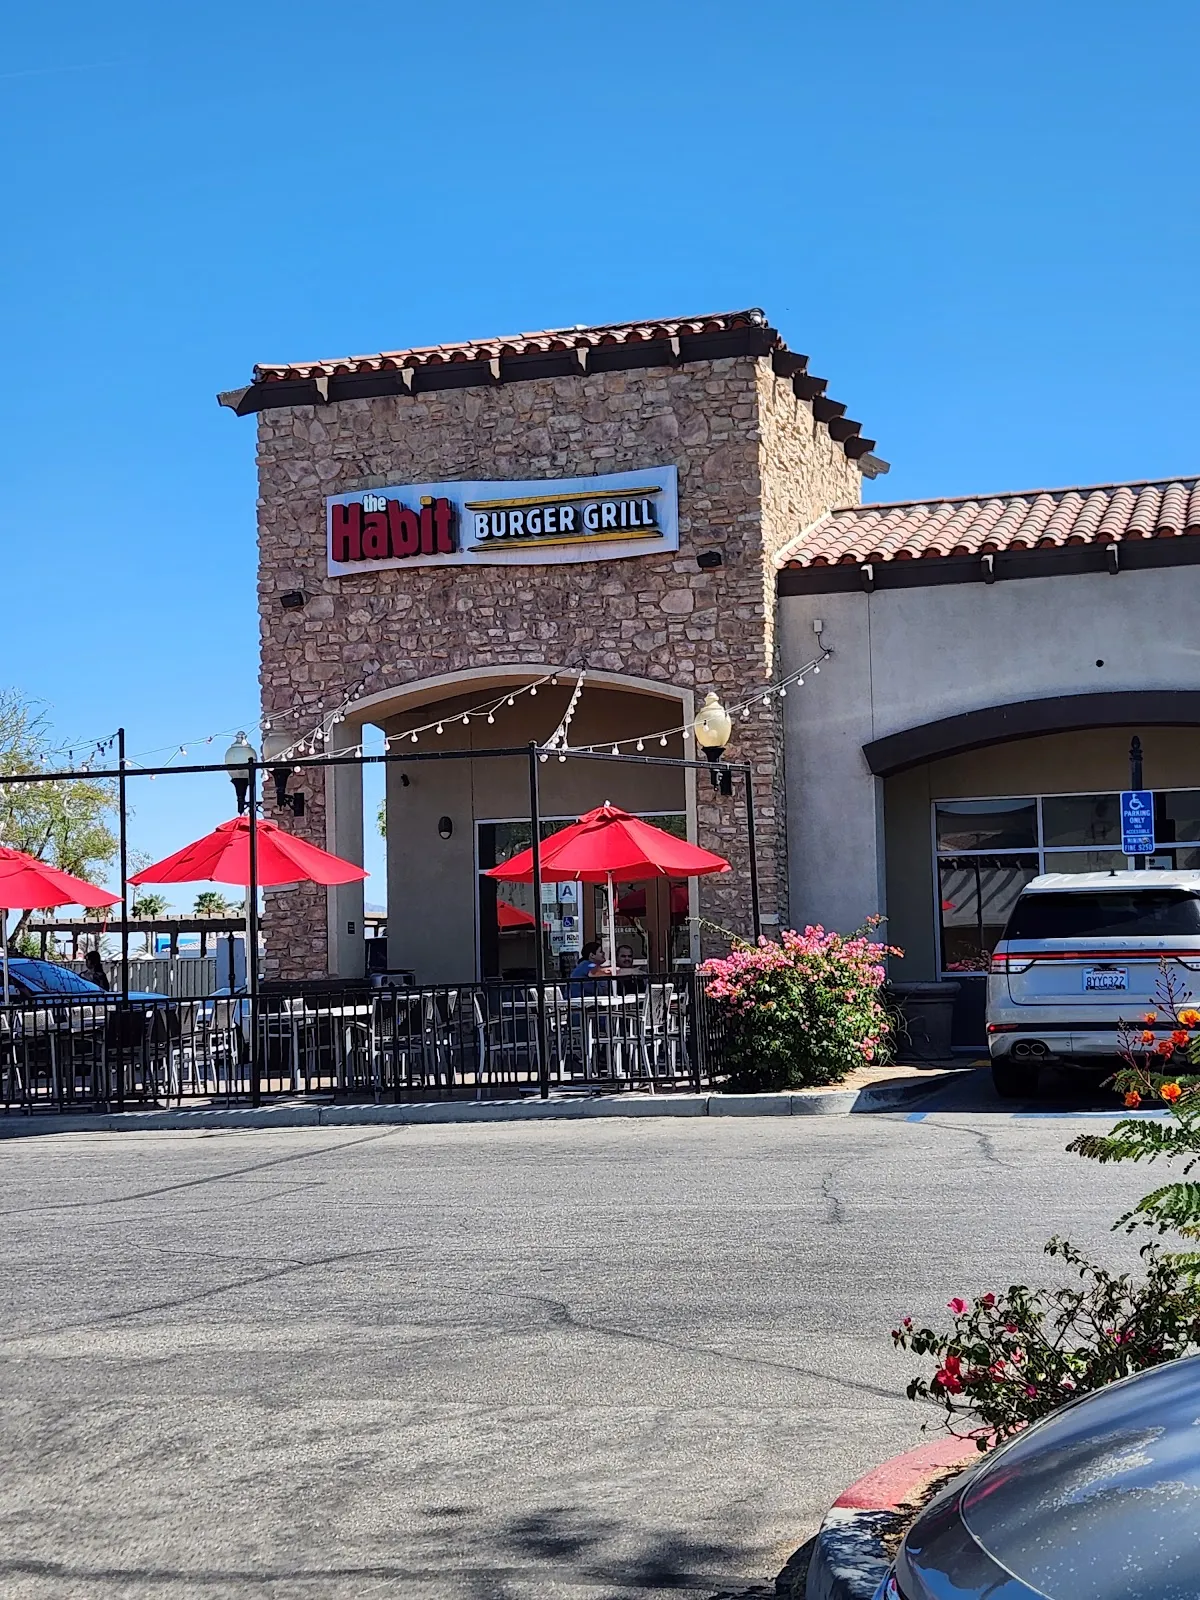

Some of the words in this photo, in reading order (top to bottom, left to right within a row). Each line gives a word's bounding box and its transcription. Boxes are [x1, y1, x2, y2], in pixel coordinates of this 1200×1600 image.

[363, 494, 386, 513] the
[332, 496, 455, 562] Habit
[475, 506, 576, 540] BURGER
[583, 499, 655, 531] GRILL
[562, 885, 573, 897] A
